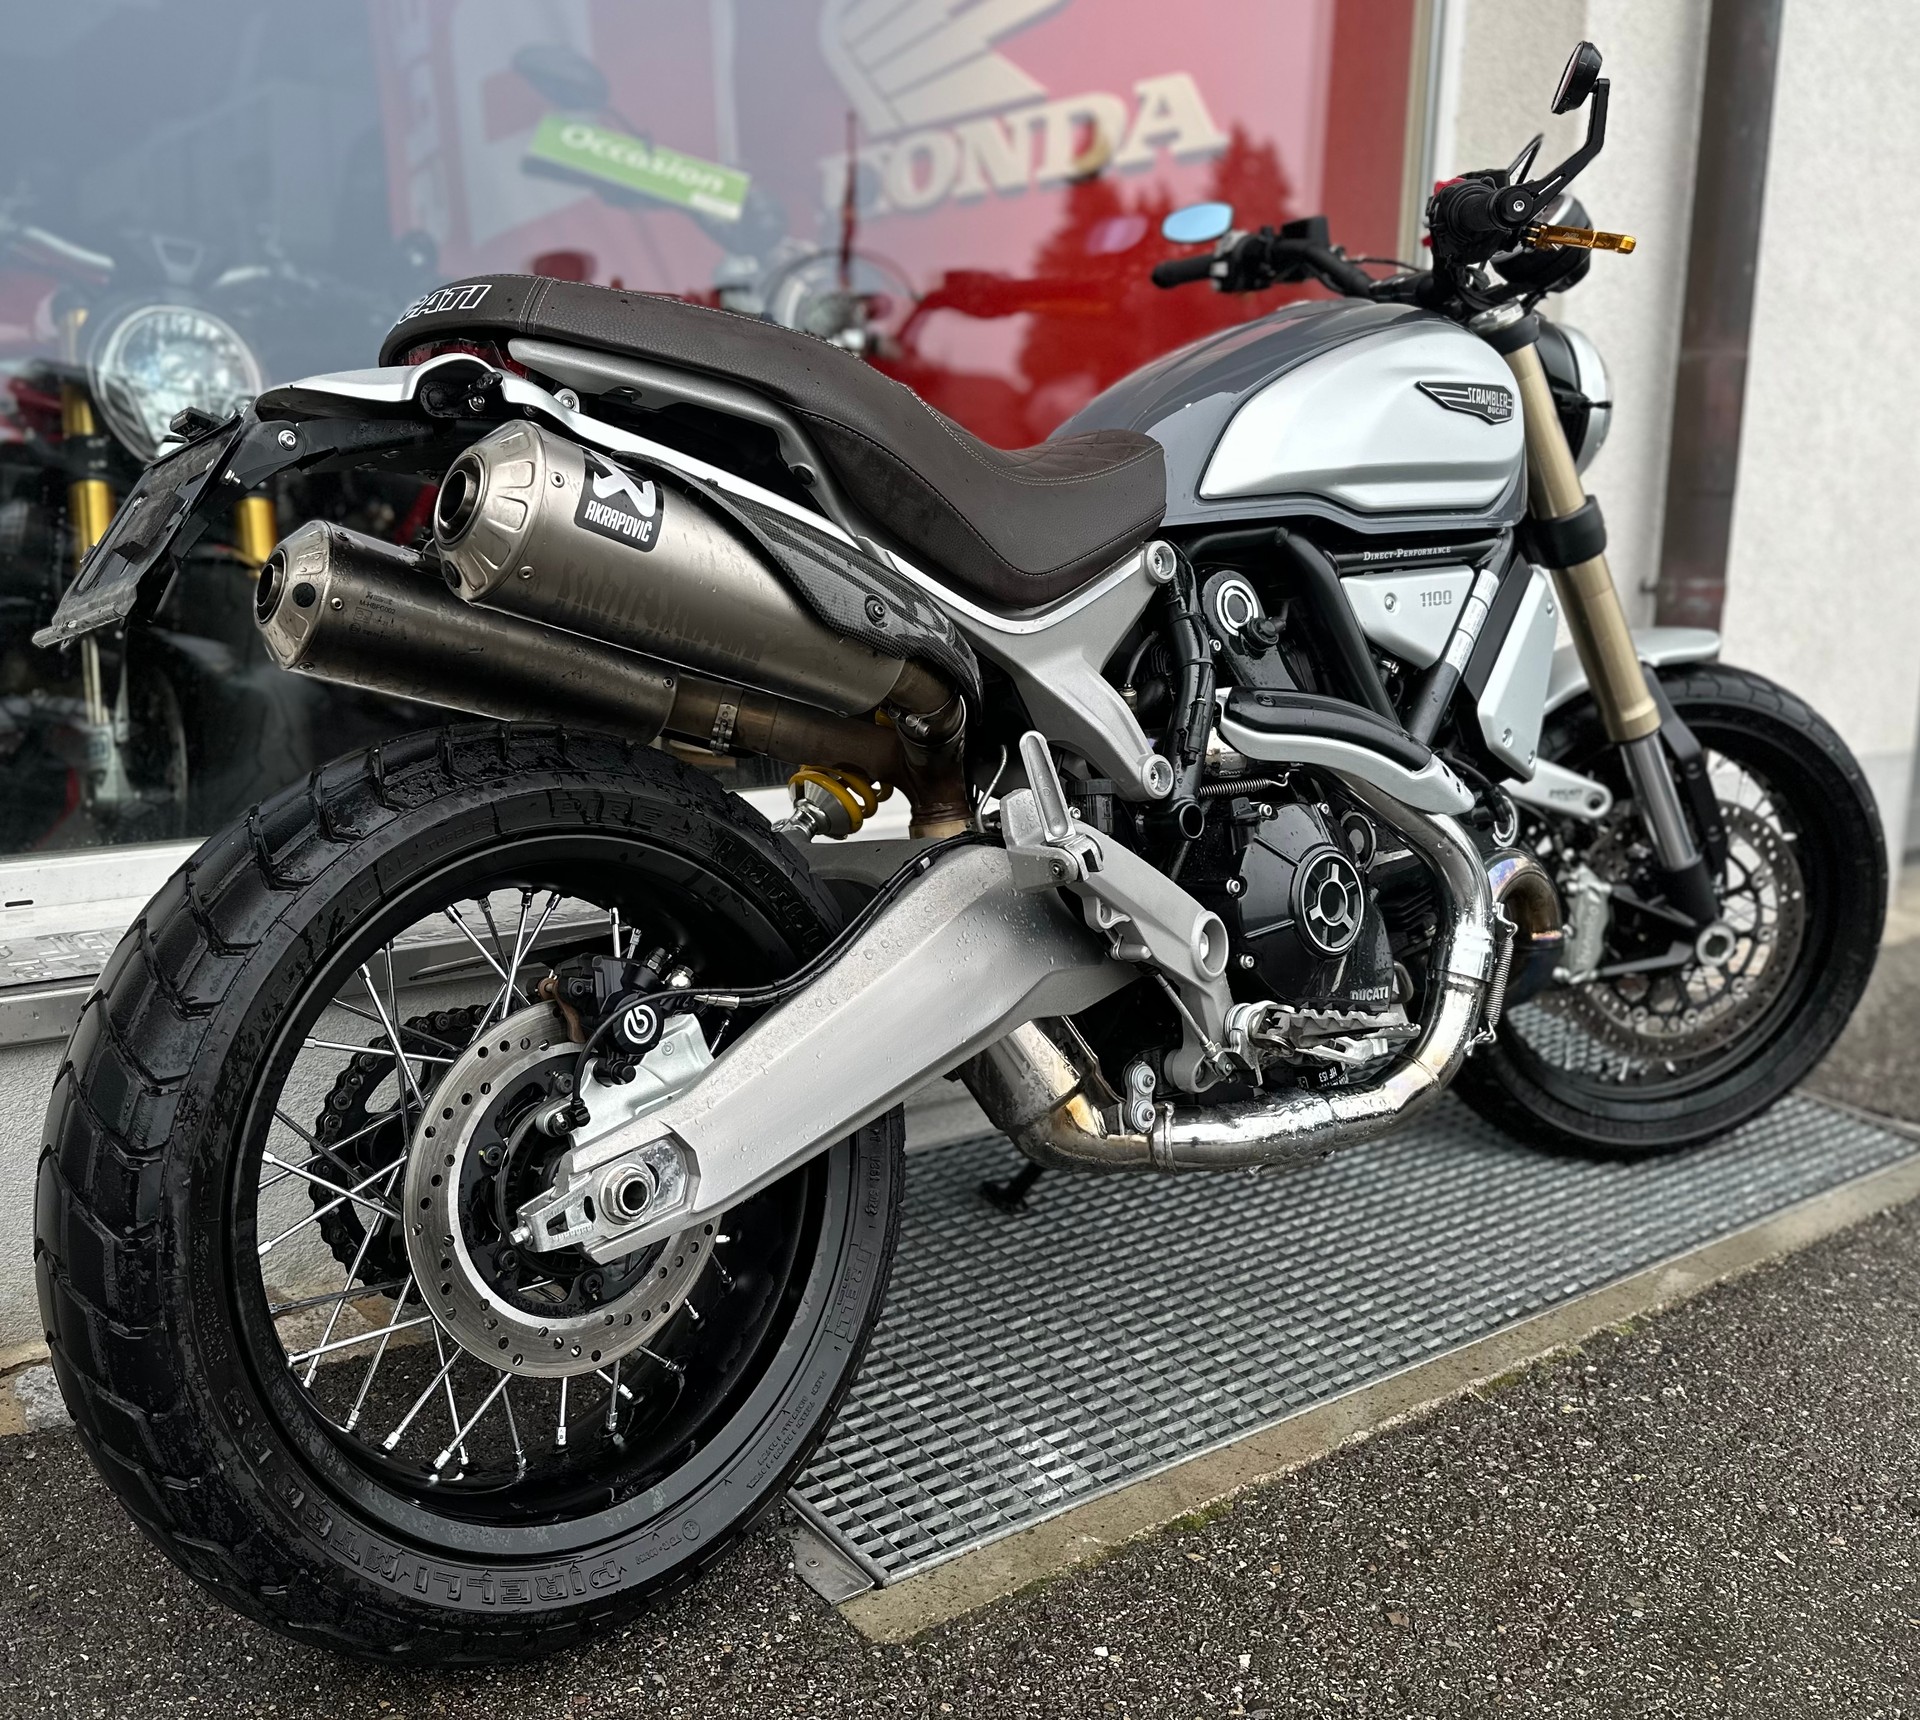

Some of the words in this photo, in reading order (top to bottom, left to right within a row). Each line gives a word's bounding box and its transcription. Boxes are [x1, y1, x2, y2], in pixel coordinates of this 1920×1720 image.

[561, 124, 725, 193] Occasion
[1467, 387, 1508, 408] SCRAMBLER
[1487, 405, 1508, 416] DUCATI
[584, 500, 653, 543] AKRAPOVIČ
[1419, 590, 1452, 607] 1100
[1350, 986, 1389, 1002] DUCATI
[412, 1559, 624, 1606] PIRELLI
